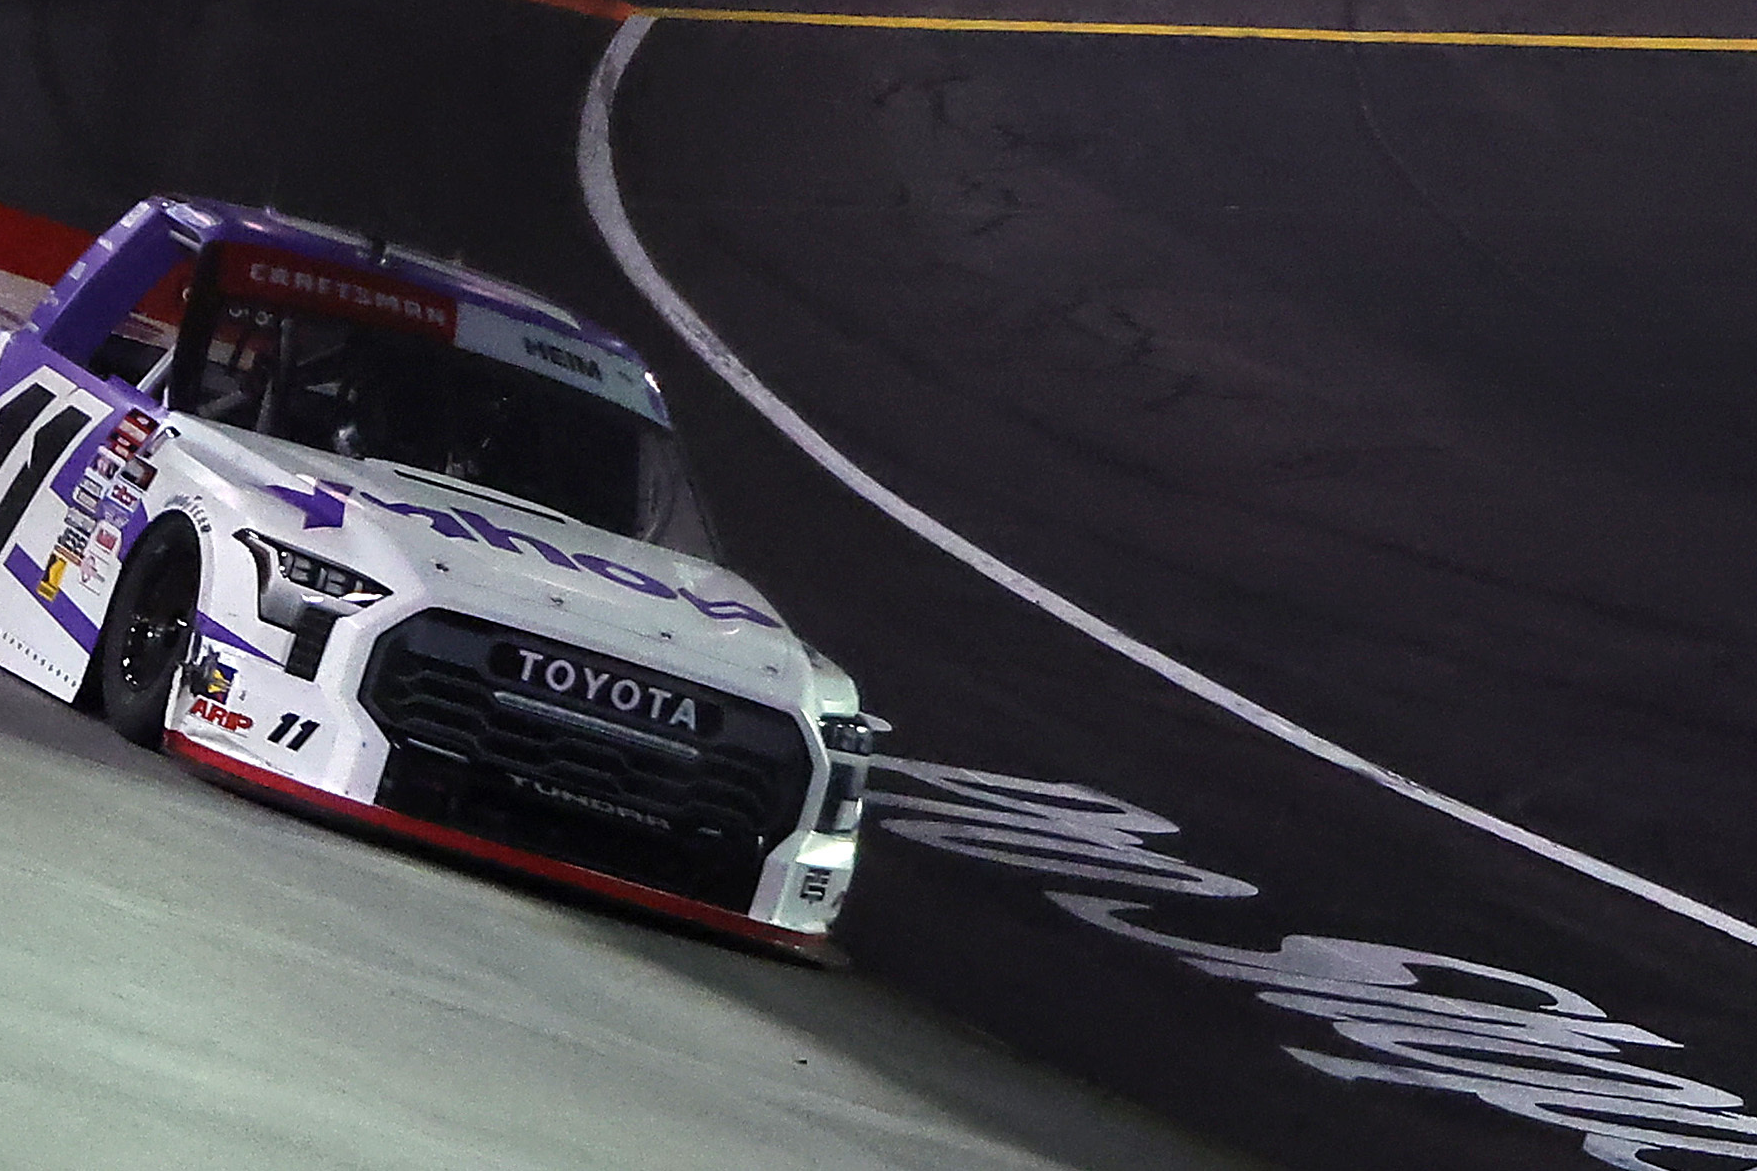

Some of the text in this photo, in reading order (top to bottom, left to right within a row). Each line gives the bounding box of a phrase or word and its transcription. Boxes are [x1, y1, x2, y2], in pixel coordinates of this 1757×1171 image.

[249, 263, 450, 327] CRAFTSMAN
[523, 336, 603, 383] HEIM
[189, 698, 254, 731] ARP
[519, 649, 698, 731] TOYOTA
[266, 711, 321, 752] 11
[509, 773, 671, 830] TUNDRA
